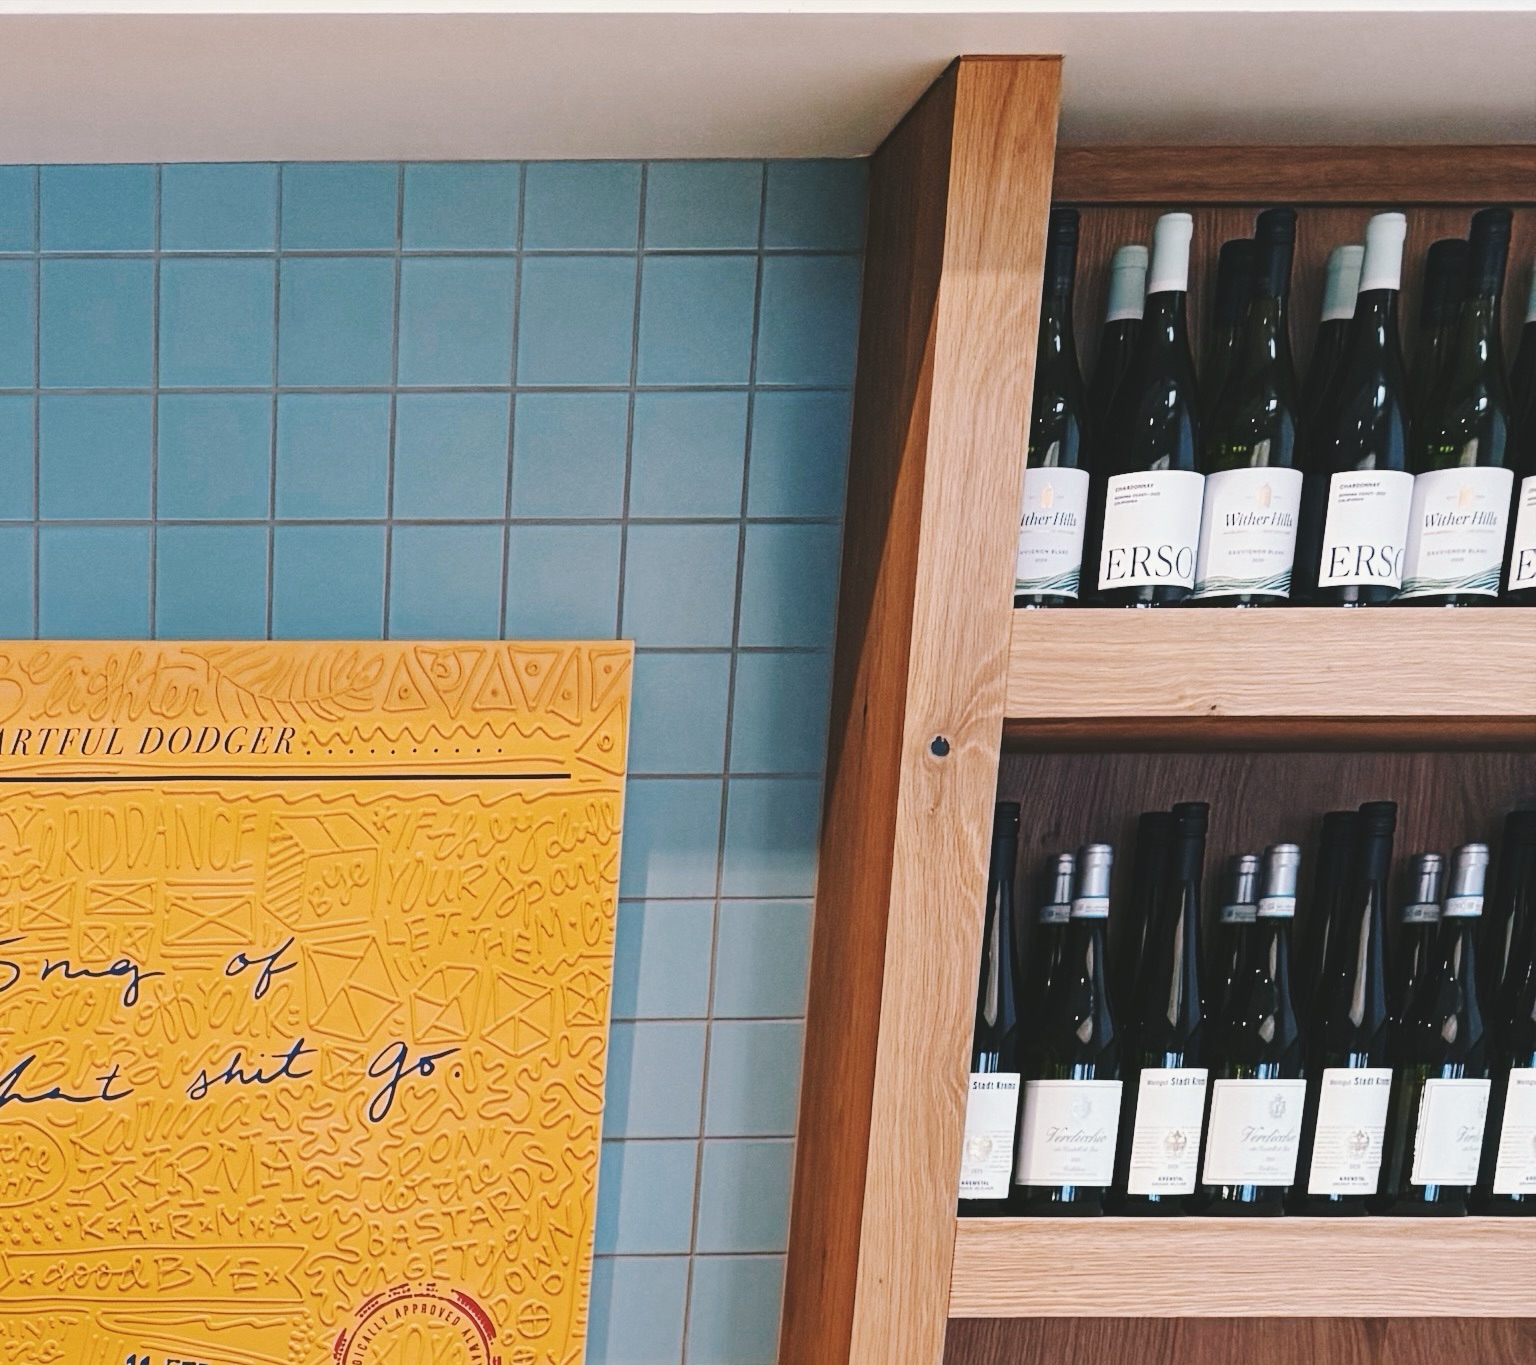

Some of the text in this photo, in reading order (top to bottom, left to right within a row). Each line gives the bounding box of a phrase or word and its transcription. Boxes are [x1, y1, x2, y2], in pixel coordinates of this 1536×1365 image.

[1225, 511, 1270, 528] Wither
[1424, 511, 1470, 528] Wither
[137, 725, 297, 757] DODGER
[225, 937, 299, 1000] of
[186, 1038, 318, 1100] shit
[394, 1303, 461, 1327] APPROVED
